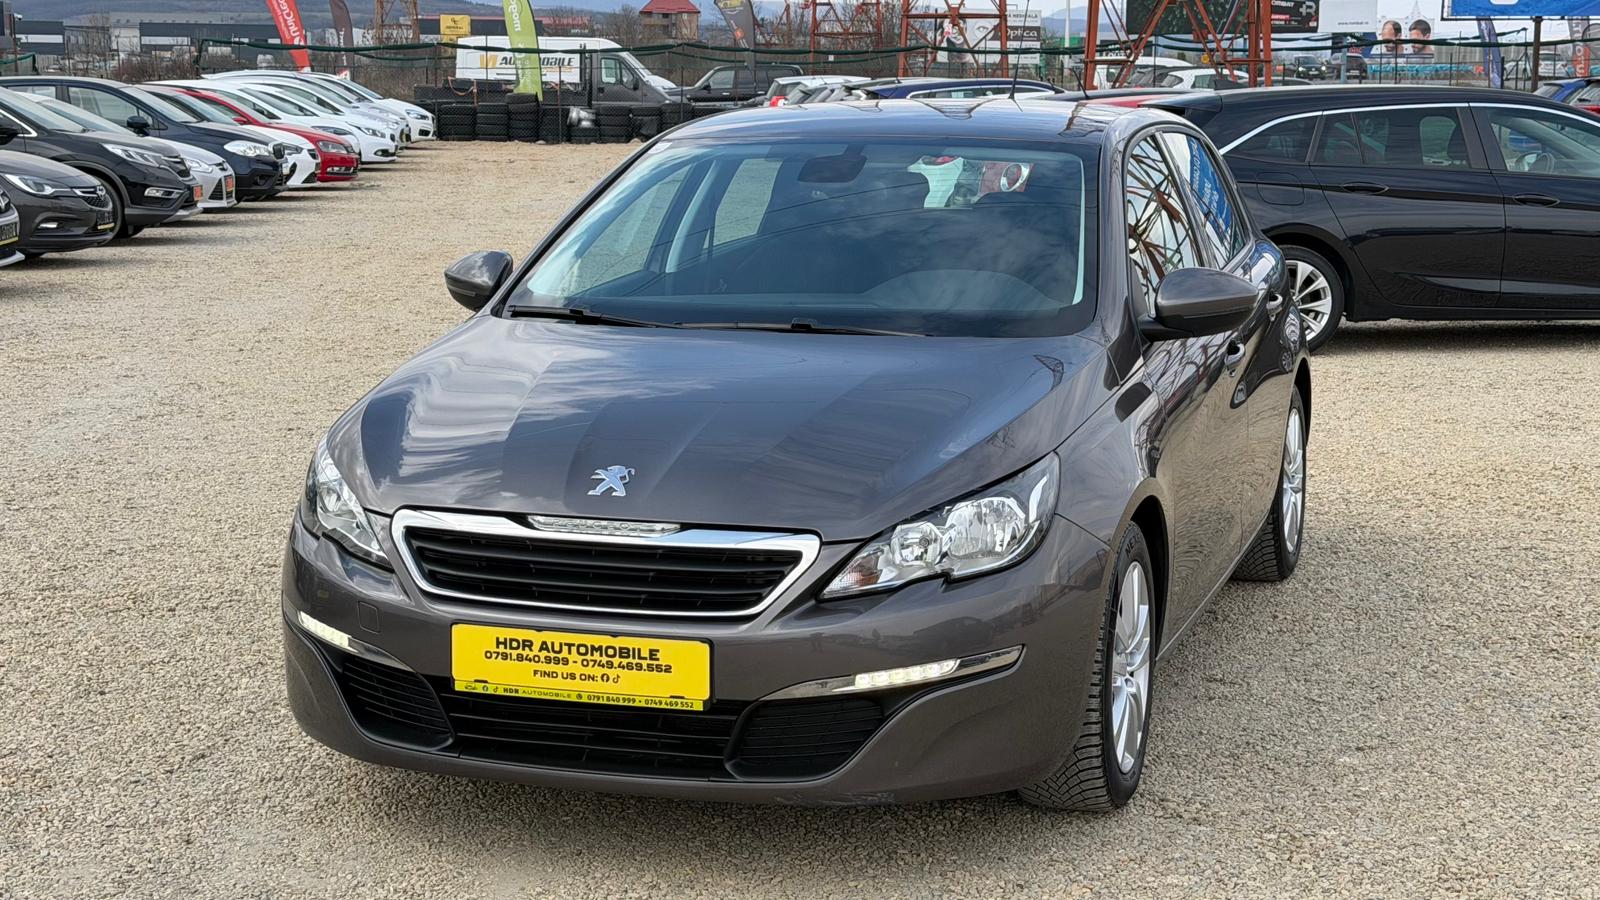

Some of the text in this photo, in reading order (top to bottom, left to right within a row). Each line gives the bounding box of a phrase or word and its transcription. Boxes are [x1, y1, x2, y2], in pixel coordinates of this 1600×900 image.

[1271, 0, 1295, 8] OMBAT
[499, 56, 576, 67] AUOBILE
[495, 636, 660, 662] HDR AUTOMOBILE
[484, 650, 570, 666] 0791.840.999
[581, 658, 672, 674] 0749.469.552
[533, 669, 598, 682] FIND US ON:
[503, 687, 519, 695] HDR
[522, 690, 572, 699] AUTOMOBILE
